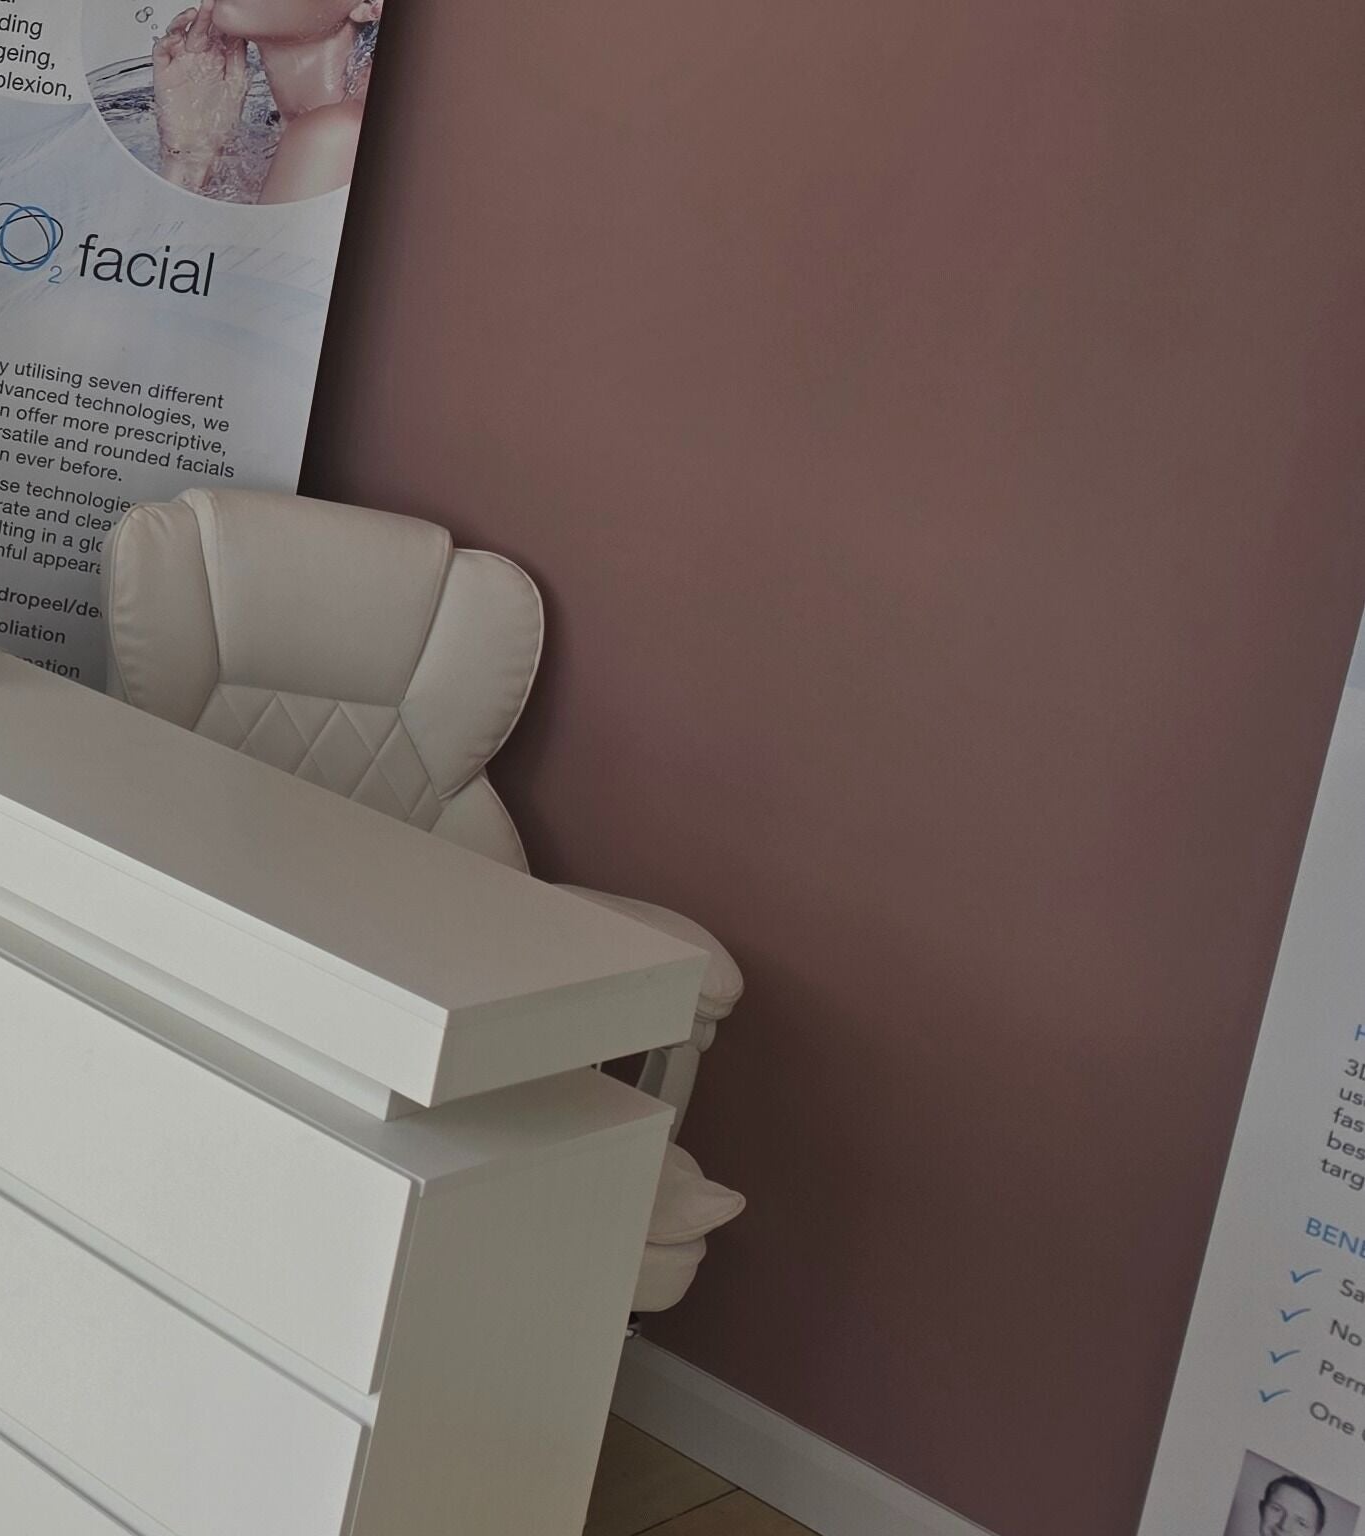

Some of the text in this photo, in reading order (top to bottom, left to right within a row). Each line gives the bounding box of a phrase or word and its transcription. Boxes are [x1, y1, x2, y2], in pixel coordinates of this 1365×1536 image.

[79, 233, 215, 297] facial
[14, 363, 83, 388] utilising
[88, 376, 142, 396] seven
[148, 383, 224, 409] different
[75, 393, 195, 429] technologies,
[203, 417, 230, 432] we
[16, 407, 58, 425] offer
[62, 416, 109, 434] more
[114, 424, 226, 457] prescriptive,
[16, 452, 55, 469] ever
[59, 456, 122, 482] before.
[54, 437, 89, 453] and
[94, 443, 171, 467] rounded
[176, 454, 235, 478] facials
[35, 507, 70, 525] and
[75, 514, 118, 532] clea
[41, 527, 57, 545] in
[62, 535, 74, 548] a
[1321, 1158, 1365, 1191] targ
[1330, 1319, 1363, 1347] No
[1309, 1401, 1355, 1435] One
